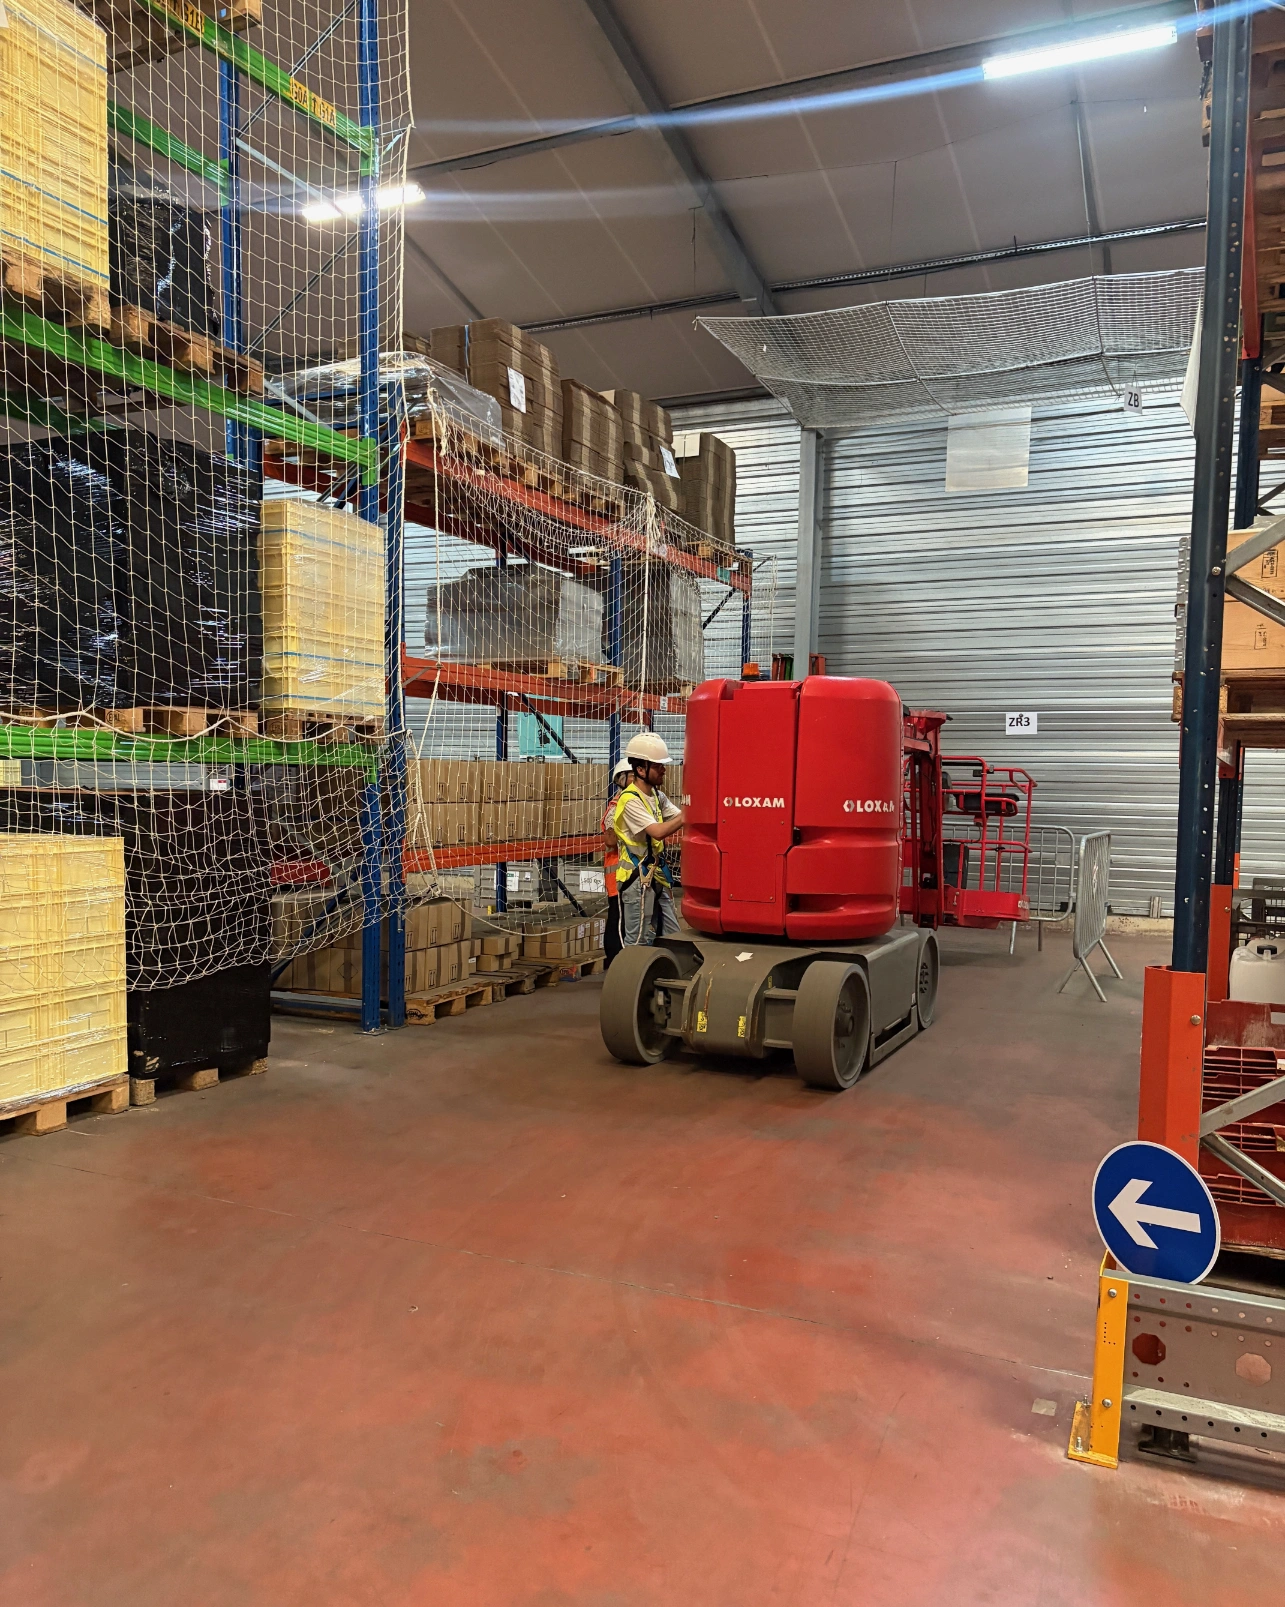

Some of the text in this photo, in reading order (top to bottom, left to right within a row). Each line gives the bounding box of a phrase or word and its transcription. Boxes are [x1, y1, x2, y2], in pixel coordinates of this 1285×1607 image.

[1128, 391, 1140, 408] ZB
[1008, 716, 1030, 727] ZR3
[734, 796, 786, 808] LOXAM
